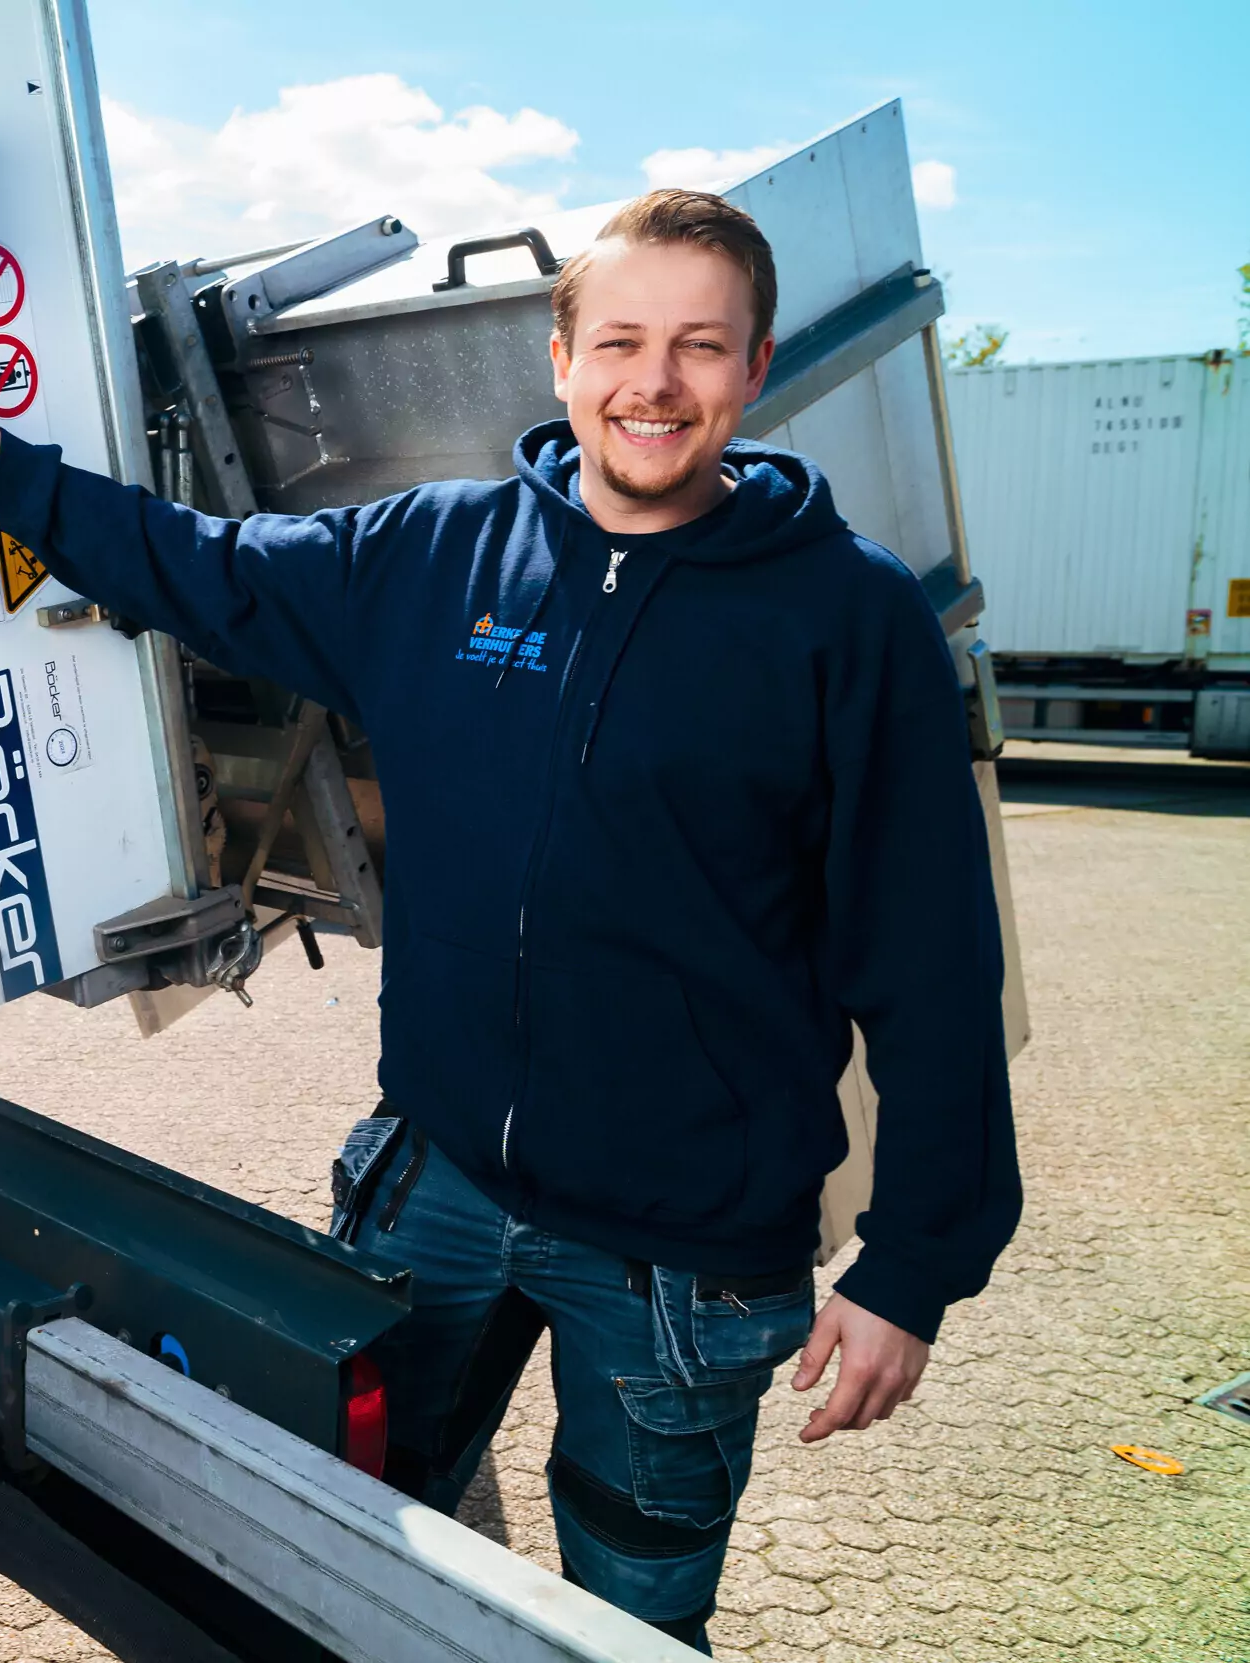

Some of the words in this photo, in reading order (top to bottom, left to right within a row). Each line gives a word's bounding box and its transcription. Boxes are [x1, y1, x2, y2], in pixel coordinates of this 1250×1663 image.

[469, 636, 542, 658] VERHUIERS
[466, 650, 487, 662] voelt
[486, 655, 496, 668] je
[527, 658, 547, 672] thuis
[44, 660, 62, 721] Böcker
